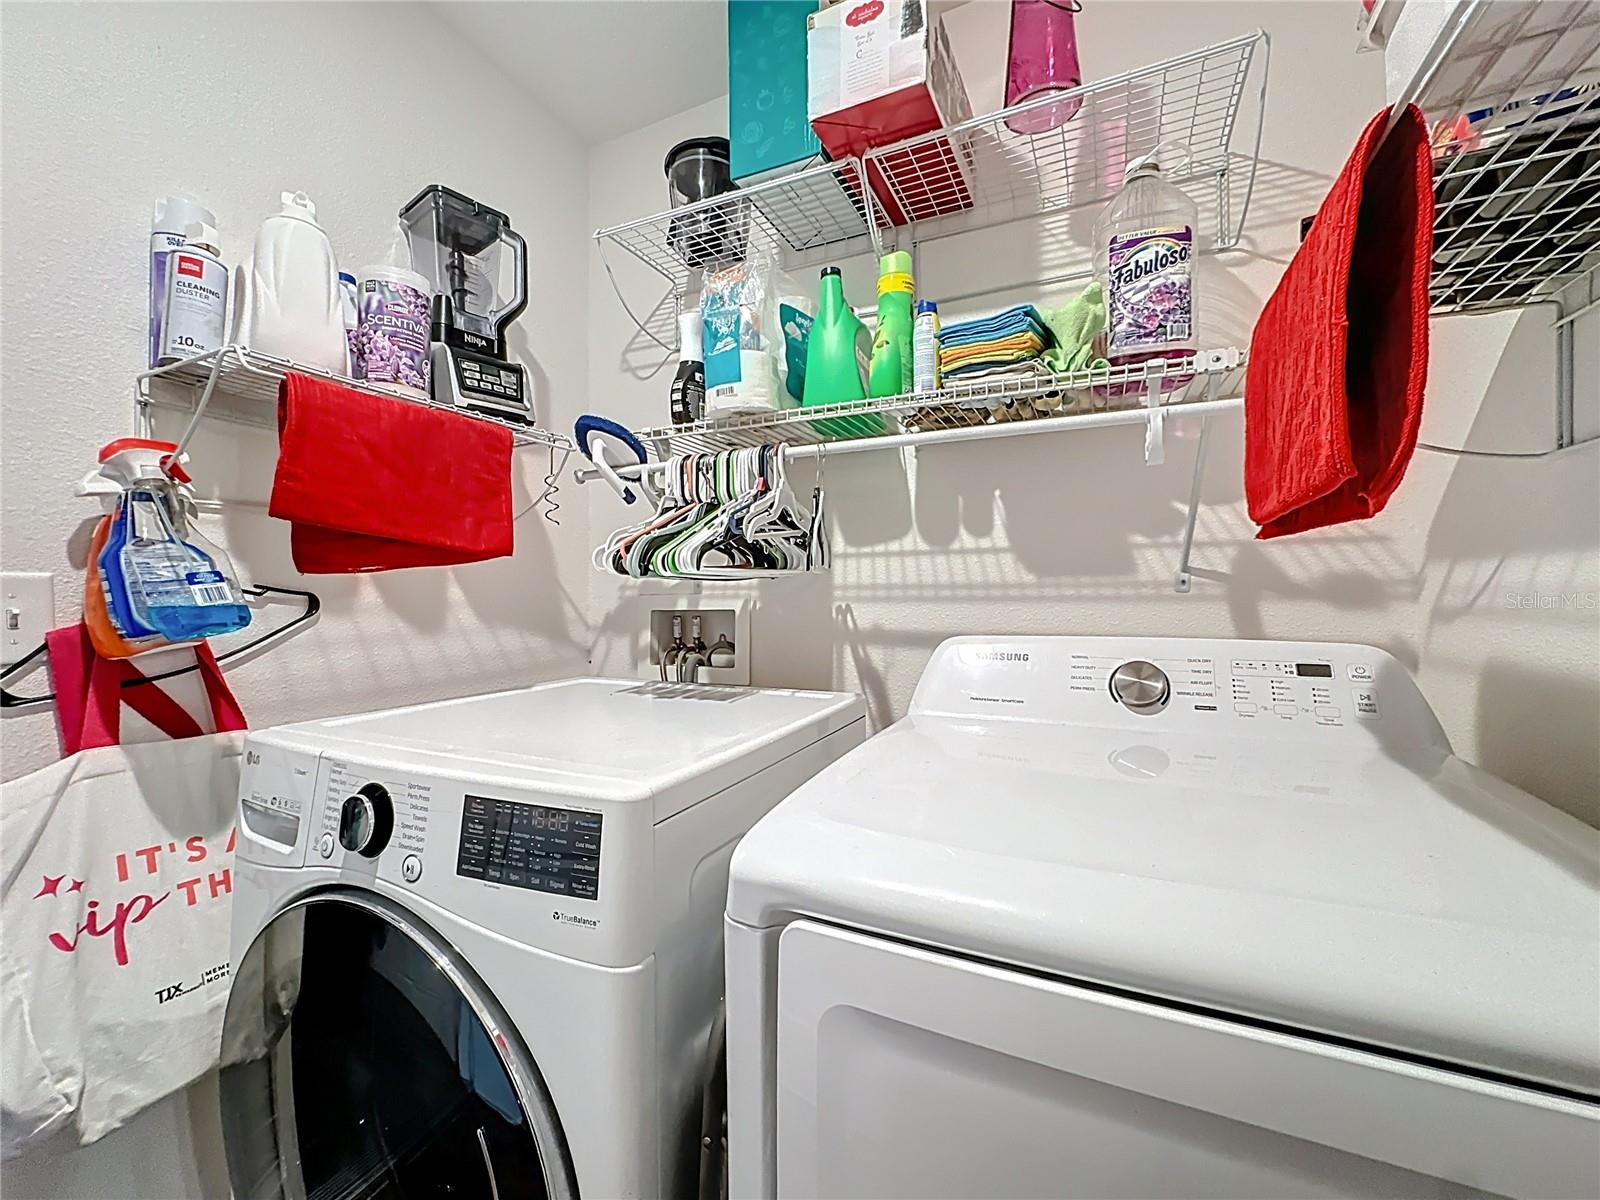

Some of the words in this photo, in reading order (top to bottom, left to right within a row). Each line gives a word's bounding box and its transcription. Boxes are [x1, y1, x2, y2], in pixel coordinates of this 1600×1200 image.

[1112, 246, 1188, 292] Fabuloso
[175, 287, 210, 301] DUSTER
[176, 280, 220, 299] CLEANING
[367, 313, 425, 336] SCENTIVA
[177, 335, 194, 347] 10
[464, 332, 487, 347] NINJA
[116, 836, 207, 882] IT'S
[48, 891, 171, 966] vip
